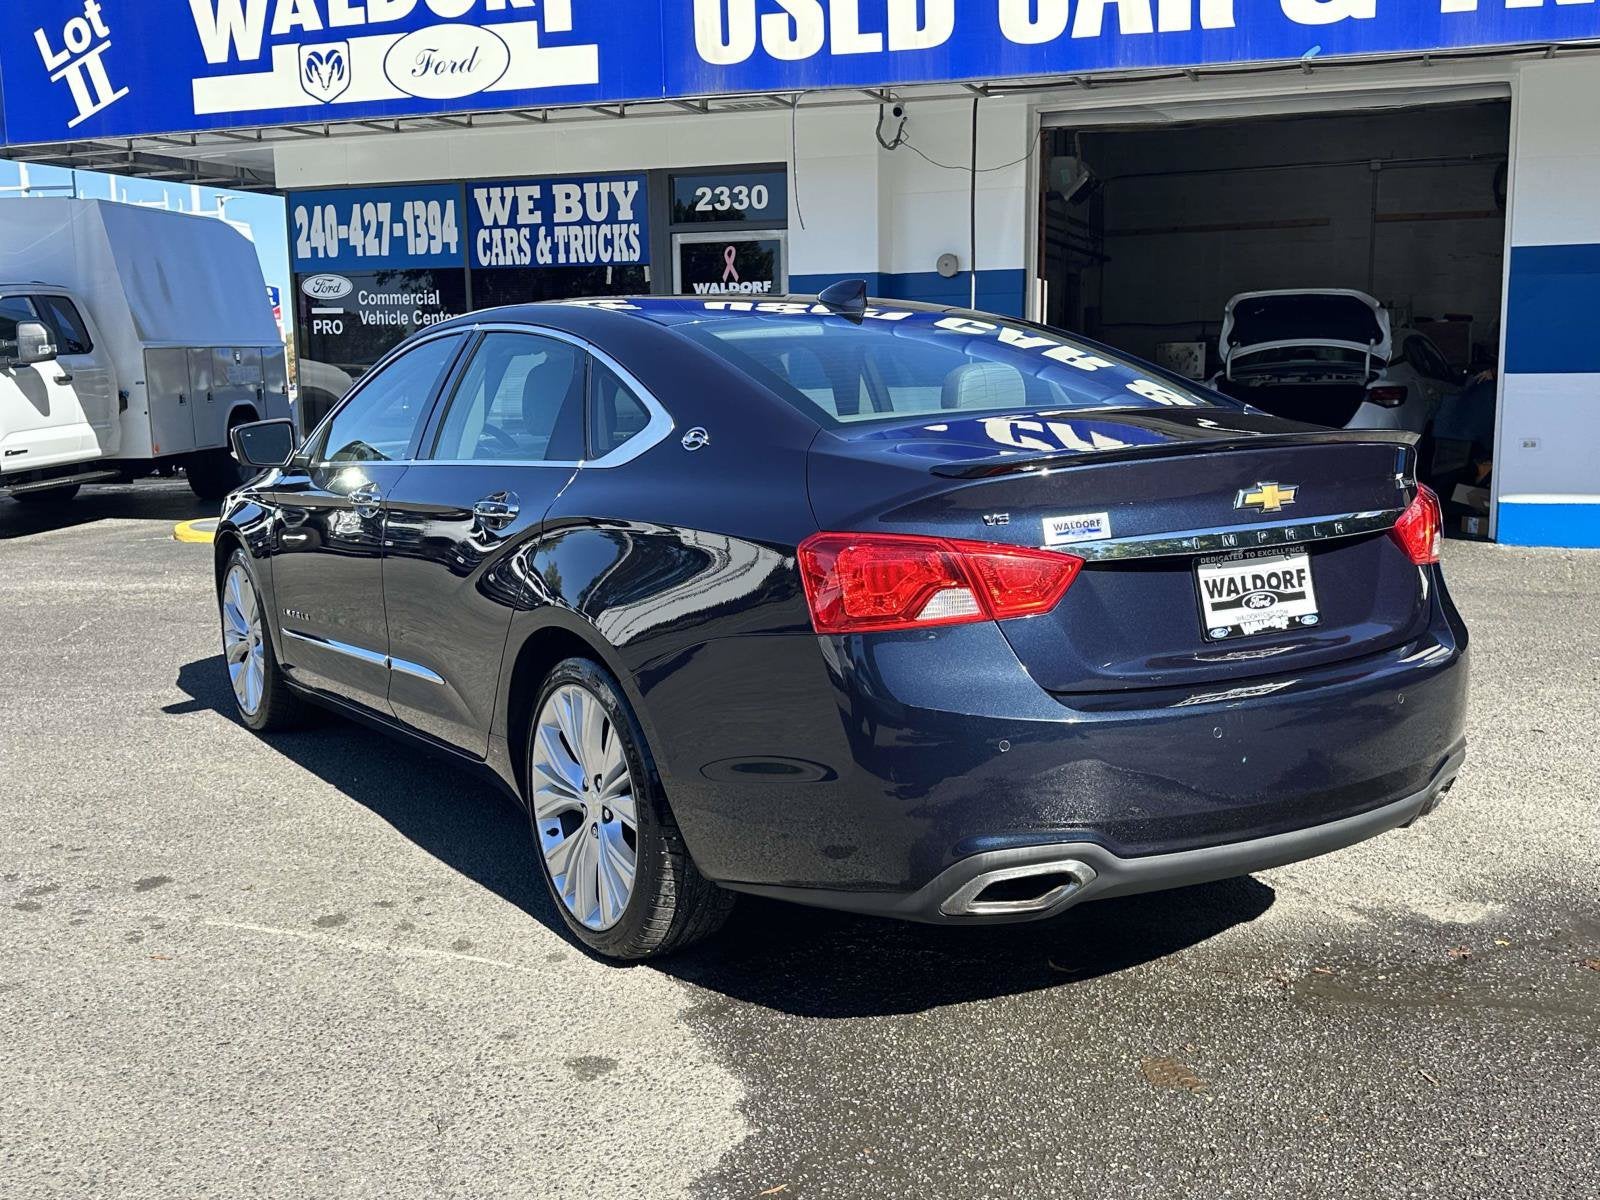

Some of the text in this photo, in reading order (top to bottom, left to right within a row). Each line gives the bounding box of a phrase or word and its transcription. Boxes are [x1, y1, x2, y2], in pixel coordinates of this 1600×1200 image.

[34, 0, 110, 72] Lot
[411, 46, 481, 77] Ford
[474, 181, 638, 226] WE BUY
[695, 184, 769, 212] 2330
[294, 200, 458, 259] 240-427-1394
[477, 223, 640, 267] CARS & TRUCKS
[312, 278, 341, 294] Ford
[693, 281, 771, 294] WALDORF
[358, 289, 440, 305] Commercial
[313, 320, 344, 335] PRO
[359, 309, 460, 325] Vehicle Cente
[1053, 519, 1101, 532] WALDORF
[1193, 522, 1345, 549] IMPALA
[1200, 552, 1244, 564] DEDICATED
[1244, 550, 1256, 559] TO
[1204, 568, 1306, 599] WALDORF
[1249, 594, 1271, 608] Ford
